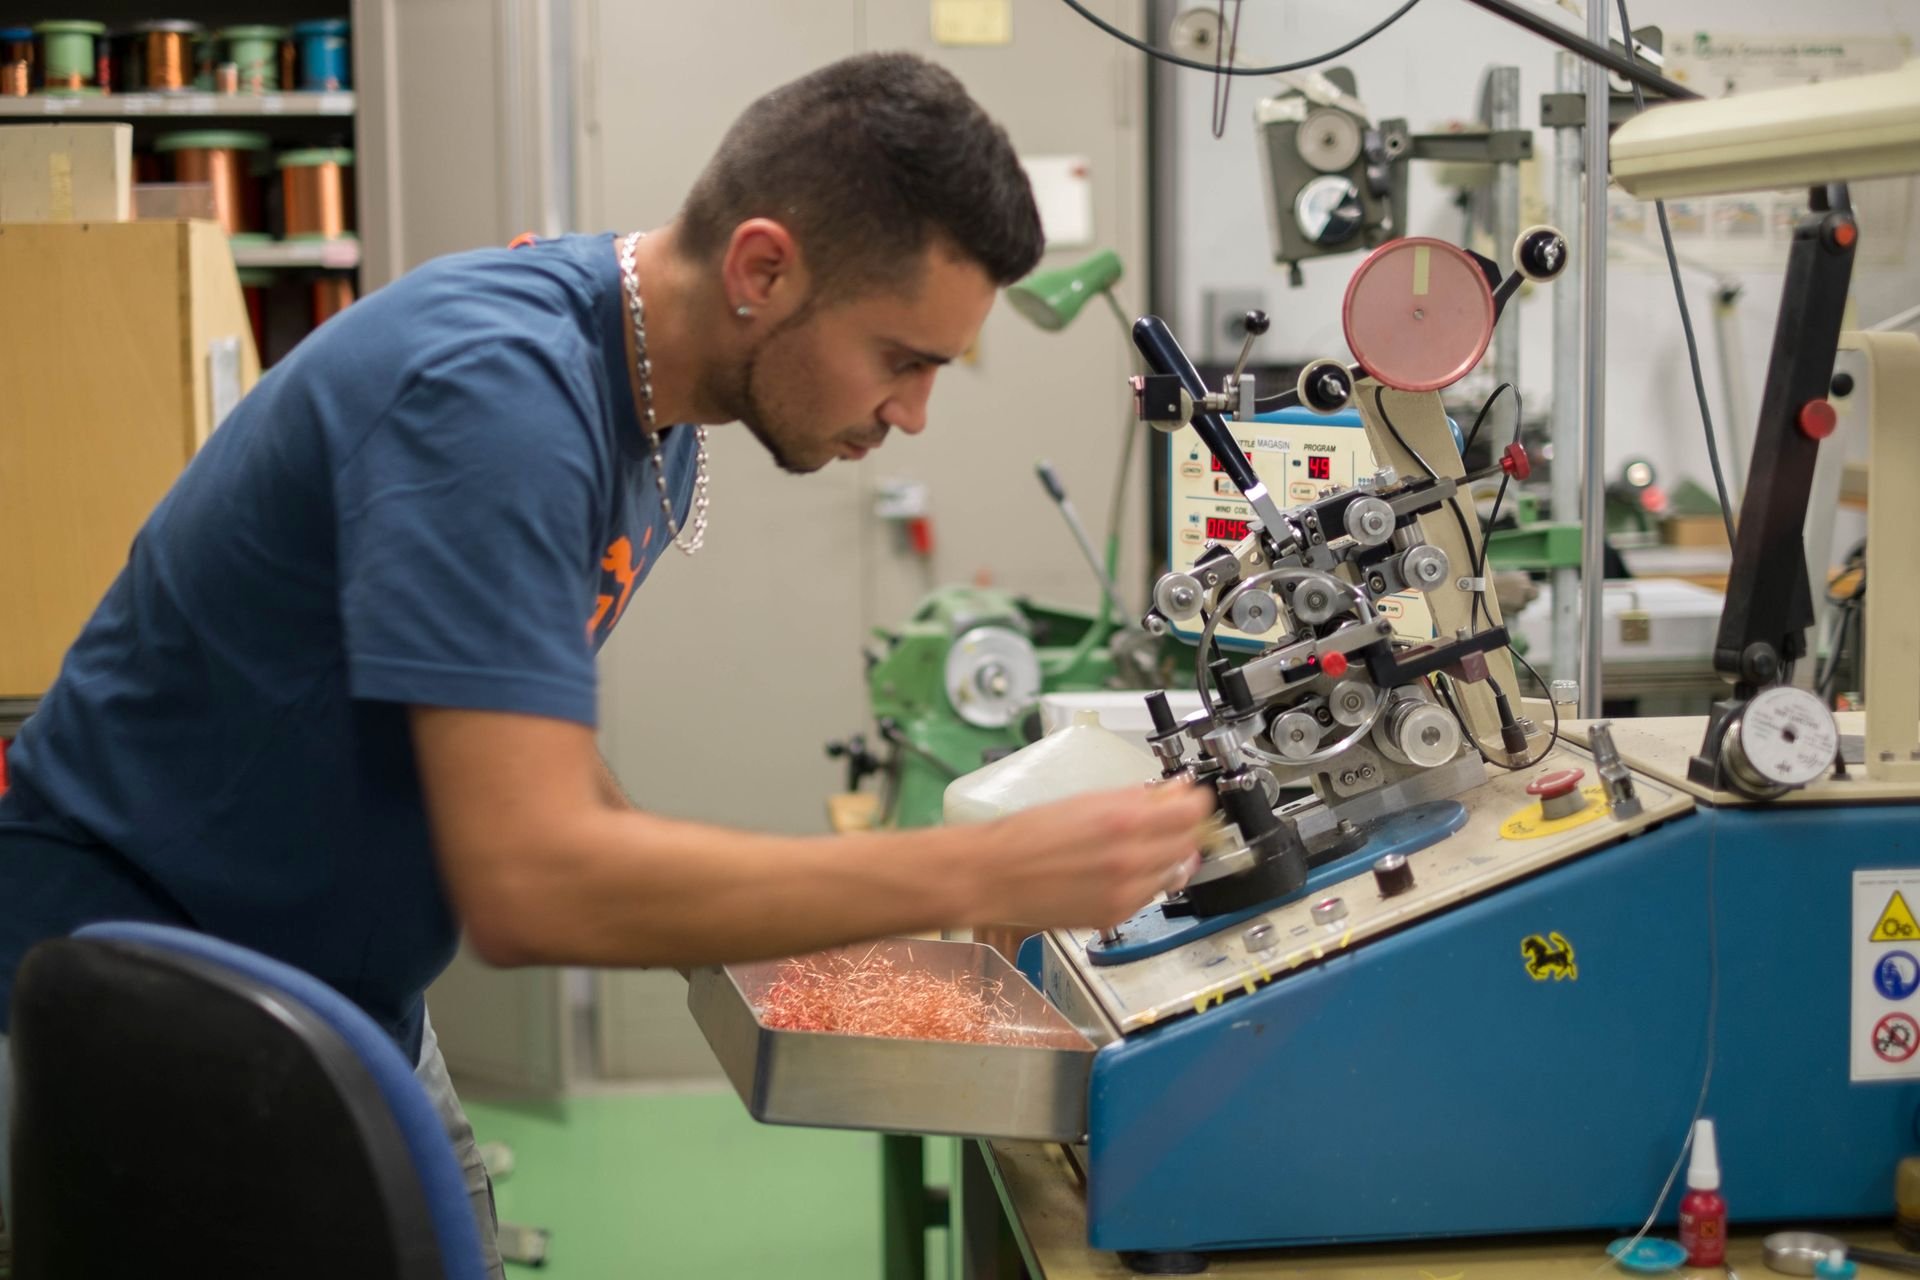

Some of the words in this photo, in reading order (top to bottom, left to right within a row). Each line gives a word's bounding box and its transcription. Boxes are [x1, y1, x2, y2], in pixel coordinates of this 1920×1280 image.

[1257, 438, 1290, 449] MAGASIN
[1303, 443, 1336, 453] PROGRAM
[1309, 458, 1329, 479] 49
[1215, 505, 1232, 514] WIND
[1234, 506, 1249, 515] COIL
